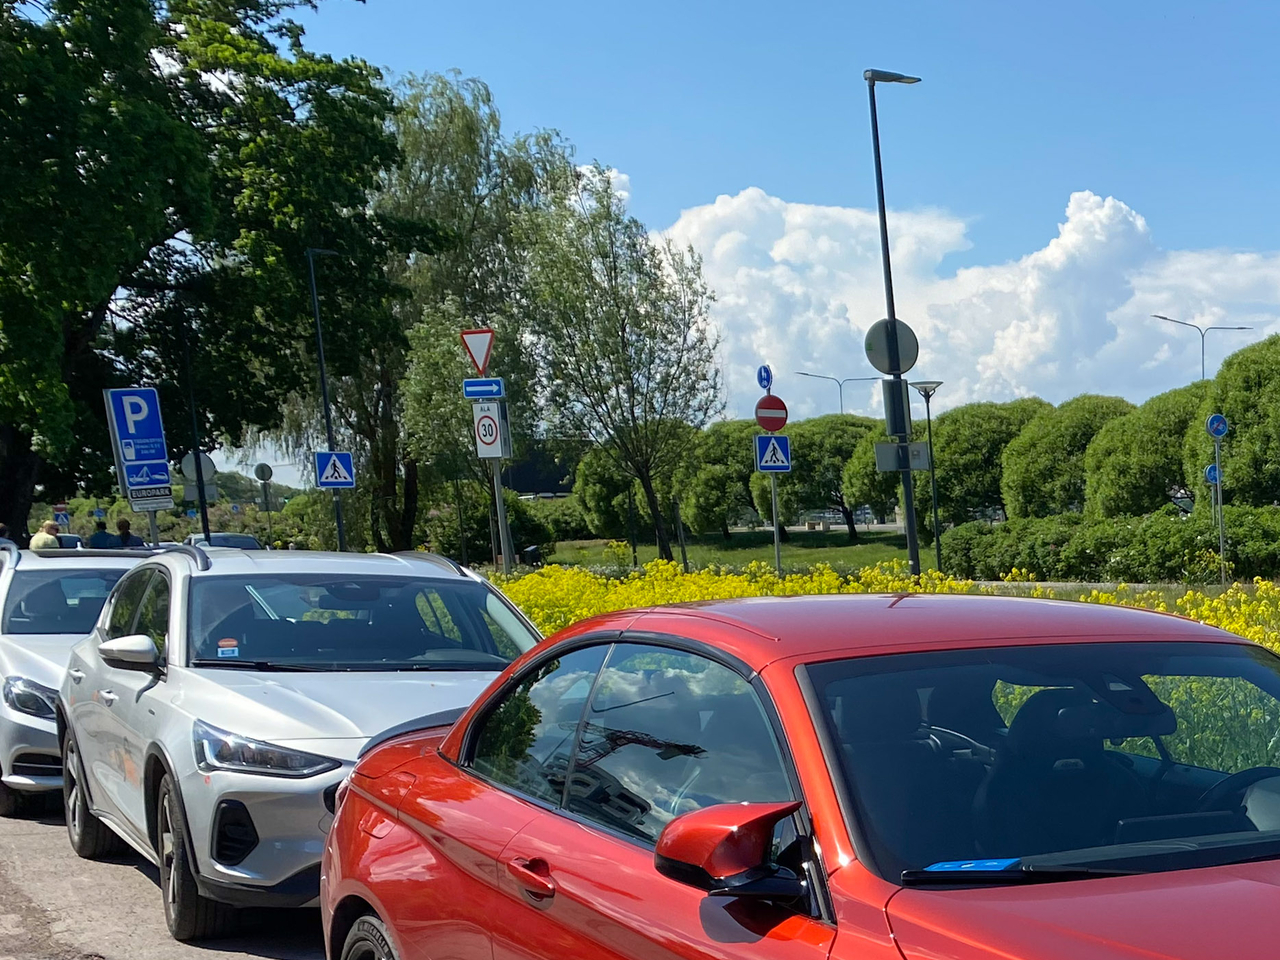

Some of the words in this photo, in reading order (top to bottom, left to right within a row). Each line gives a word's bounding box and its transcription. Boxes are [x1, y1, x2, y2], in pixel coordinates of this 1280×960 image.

[121, 395, 149, 434] P
[481, 423, 494, 438] 30
[131, 488, 171, 498] EUROPARK
[363, 921, 390, 954] MICHELIN
